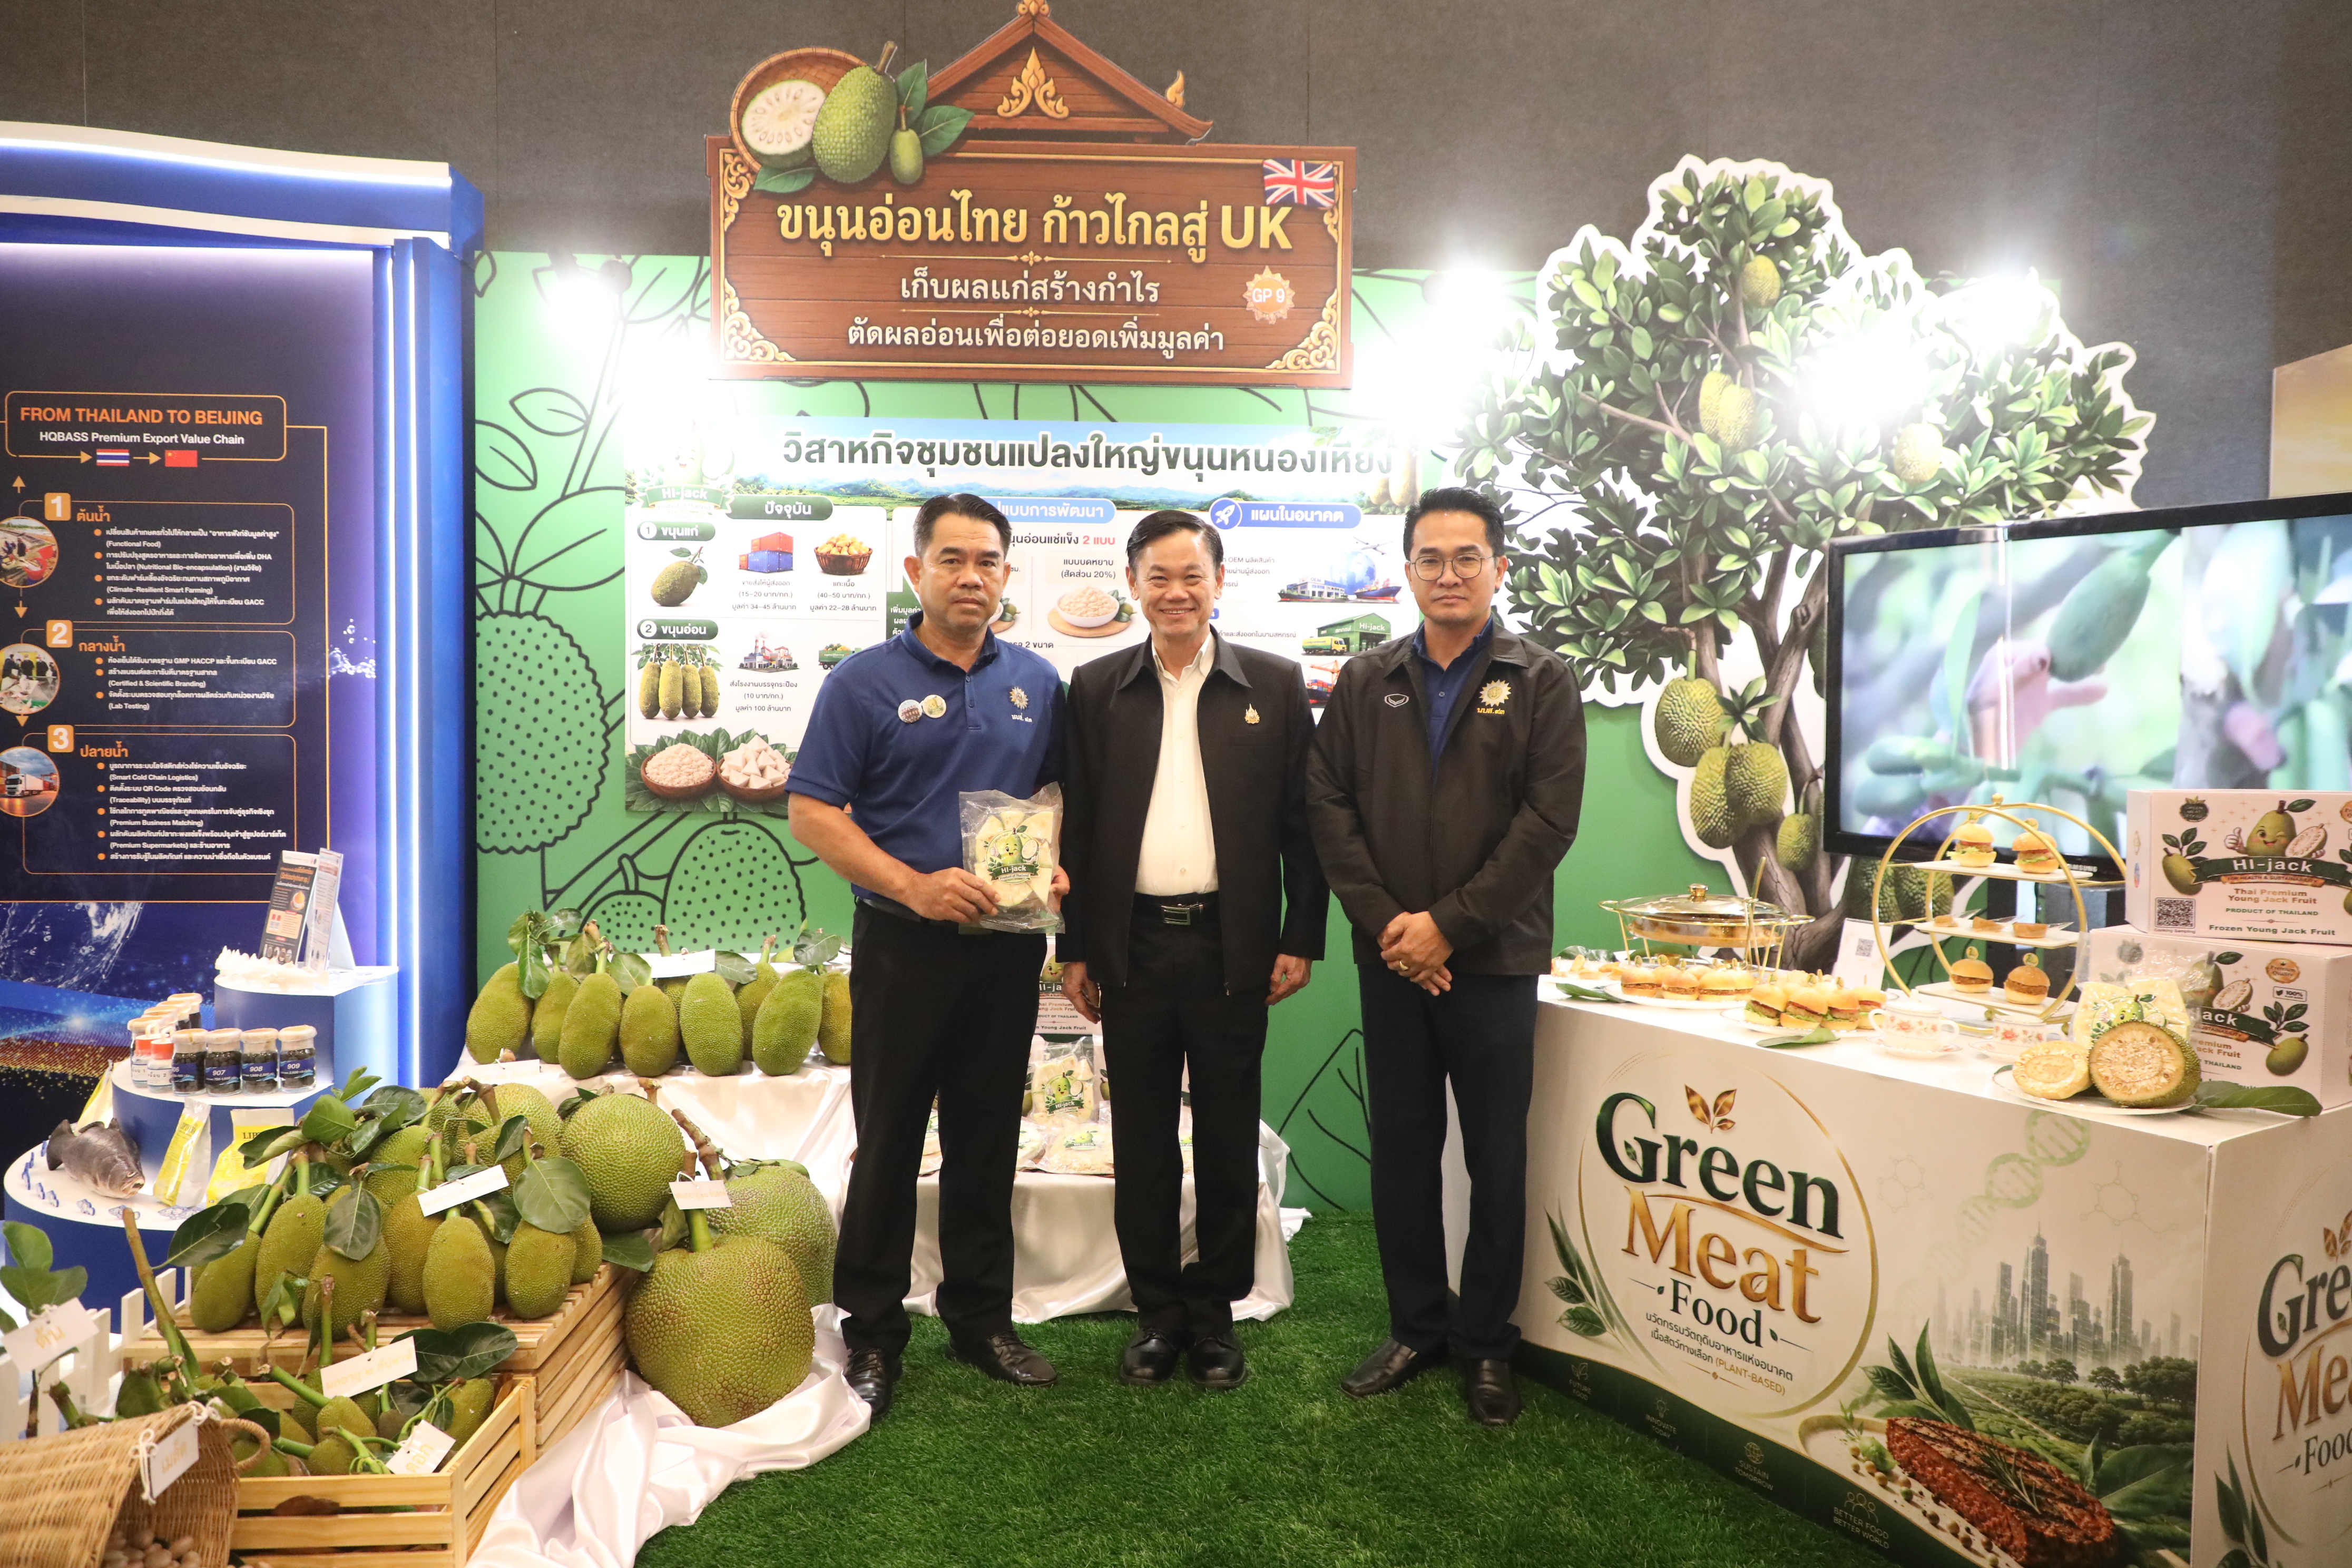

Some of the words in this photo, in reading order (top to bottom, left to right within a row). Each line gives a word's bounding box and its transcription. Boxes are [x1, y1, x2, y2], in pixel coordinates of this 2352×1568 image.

[777, 190, 1028, 257] ขนุนอ่อนไทย
[1043, 193, 1209, 262] ก้าวไกลสู่
[1220, 206, 1293, 250] UK
[900, 270, 1160, 304] เก็บผลแก่สร้างกำไร
[1251, 287, 1271, 304] GP
[1273, 287, 1285, 304] 9
[847, 316, 1224, 360] ตัดผลอ่อนเพื่อต่อยอดเพิ่มมูลค่า
[21, 407, 71, 422] FROM
[75, 408, 163, 424] THAILAND
[166, 409, 191, 424] TO
[195, 410, 263, 425] BEIJING
[40, 431, 89, 444] HQBASS
[91, 432, 141, 443] Premium
[143, 433, 179, 445] Export
[180, 434, 210, 444] Value
[213, 434, 244, 445] Chain
[783, 431, 1392, 483] วิสาหกิจชุมชนแปลงใหญ่ขนุนหนองเหียง
[51, 495, 63, 517] 1
[76, 505, 111, 522] ต้นน้ำ
[765, 501, 811, 518] ปัจจุบัน
[1251, 502, 1344, 523] แผนในอนาคต
[661, 524, 699, 540] ขนุนแก่
[1083, 535, 1090, 545] 2
[1093, 536, 1115, 545] แบบ
[1061, 570, 1091, 579] (สัดส่วน
[1094, 571, 1116, 579] 20%)
[185, 586, 213, 595] Farming)
[52, 622, 67, 644] 2
[645, 624, 652, 633] 2
[661, 625, 707, 638] ขนุนอ่อน
[1359, 622, 1386, 631] Hi-jack
[79, 635, 126, 652] กลางน้ำ
[53, 727, 69, 750] 3
[80, 740, 129, 758] ปลายน้ำ
[172, 819, 203, 827] Matching)
[1001, 865, 1027, 874] HI-jack
[2232, 858, 2314, 874] HI-jack
[2228, 895, 2260, 904] Young
[2246, 926, 2278, 935] Young
[2217, 1049, 2241, 1058] Fruit
[2204, 1060, 2242, 1070] THAILAND
[1595, 1091, 1845, 1241] Green
[1621, 1186, 1823, 1325] Meat
[1669, 1279, 1765, 1349] Food
[35, 1325, 65, 1349] ต้น
[1646, 1312, 1794, 1381] นวัตกรรมวัตถุดิบอาหารแห่งอนาคต
[326, 1371, 362, 1390] ผลอายุ
[377, 1348, 413, 1371] สัปดาห์
[1651, 1329, 1713, 1365] เนื้อสัตว์ทางเลือก
[1715, 1357, 1787, 1396] (PLANT-BASED)
[1569, 1379, 1592, 1395] FUTURE
[1572, 1388, 1589, 1402] FOOD
[1645, 1414, 1678, 1435] INNOVATE
[1651, 1425, 1671, 1440] TODAY
[405, 1444, 435, 1474] ดอก
[1734, 1467, 1775, 1492] TOMORROW
[1738, 1459, 1770, 1482] SUSTAIN
[1833, 1506, 1864, 1528] BETTER
[1865, 1521, 1889, 1541] FOOD
[1832, 1516, 1862, 1537] BETTER
[1862, 1531, 1890, 1550] WORLD
